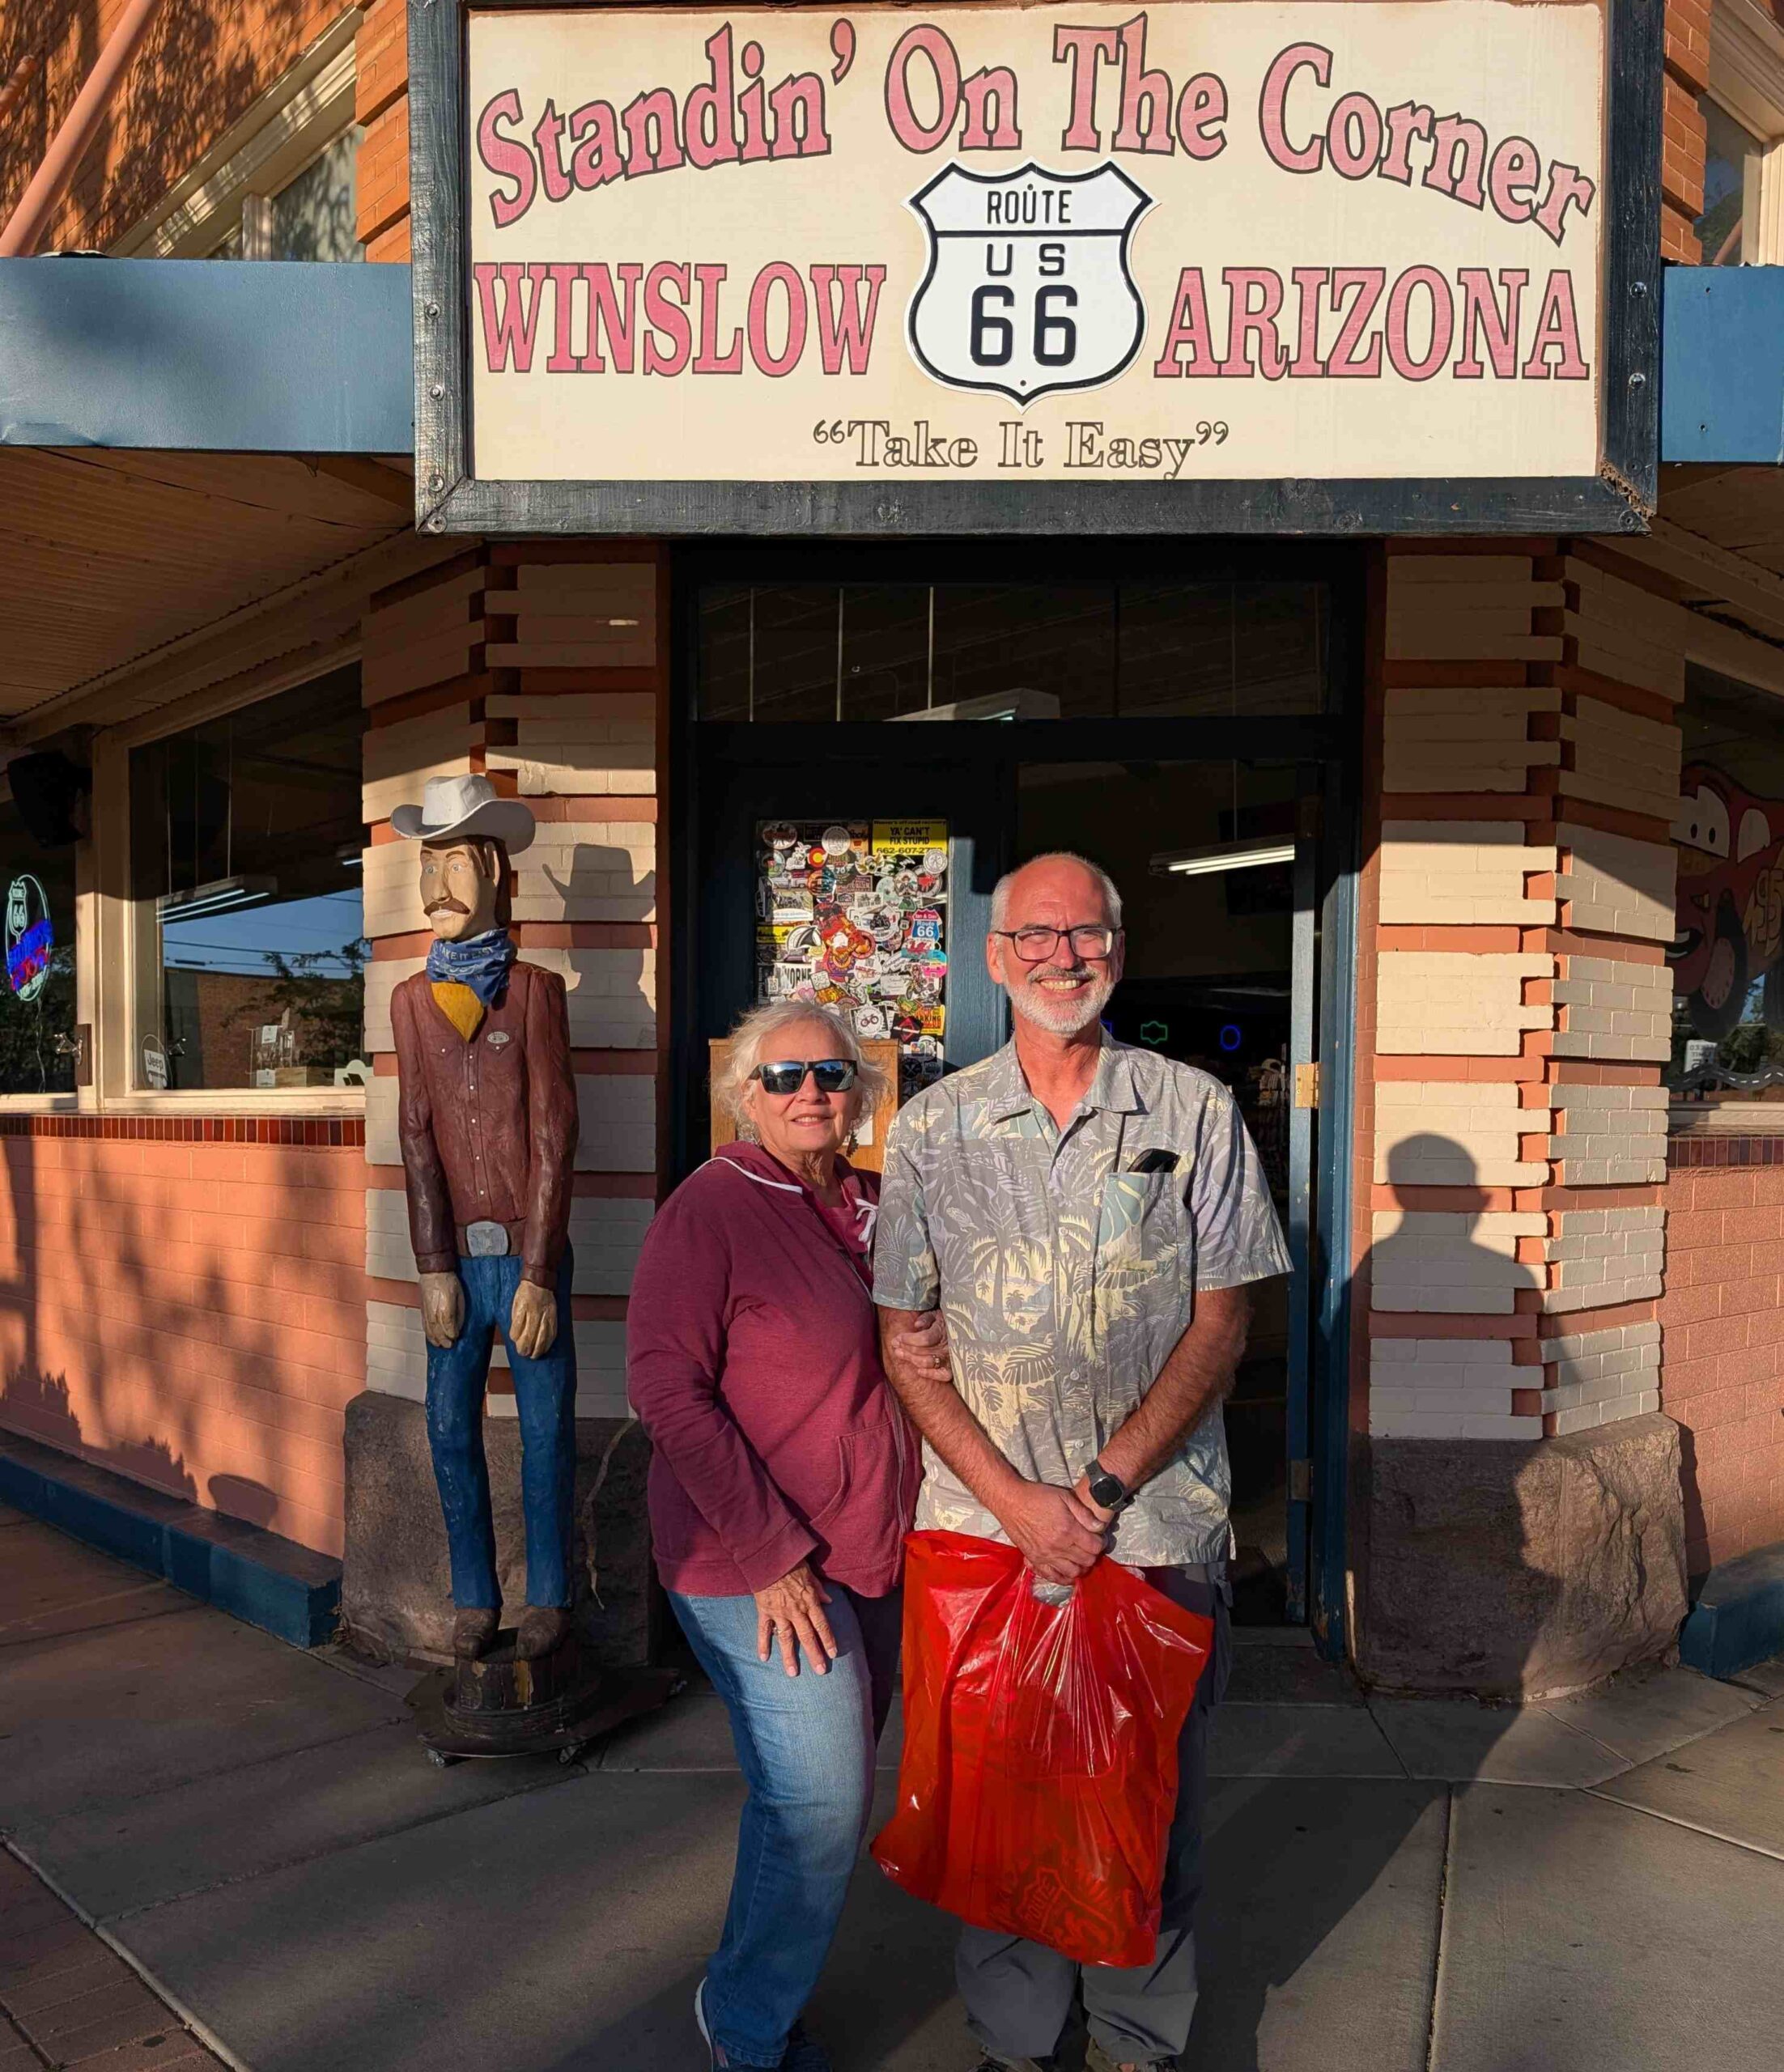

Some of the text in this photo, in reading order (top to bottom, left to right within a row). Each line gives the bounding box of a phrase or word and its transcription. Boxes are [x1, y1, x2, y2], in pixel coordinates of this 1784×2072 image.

[884, 23, 1023, 154] On
[1052, 11, 1229, 161] The
[1258, 41, 1596, 248] Corner
[987, 189, 1073, 224] ROUTE
[473, 261, 1591, 381] WINSLOW ARIZONA
[970, 284, 1078, 367] 66
[996, 421, 1044, 468] It
[890, 836, 930, 845] FIX STUPID
[904, 826, 930, 835] CAN'T
[13, 904, 25, 928] 66
[917, 926, 934, 937] 66
[147, 1053, 164, 1073] Jeep
